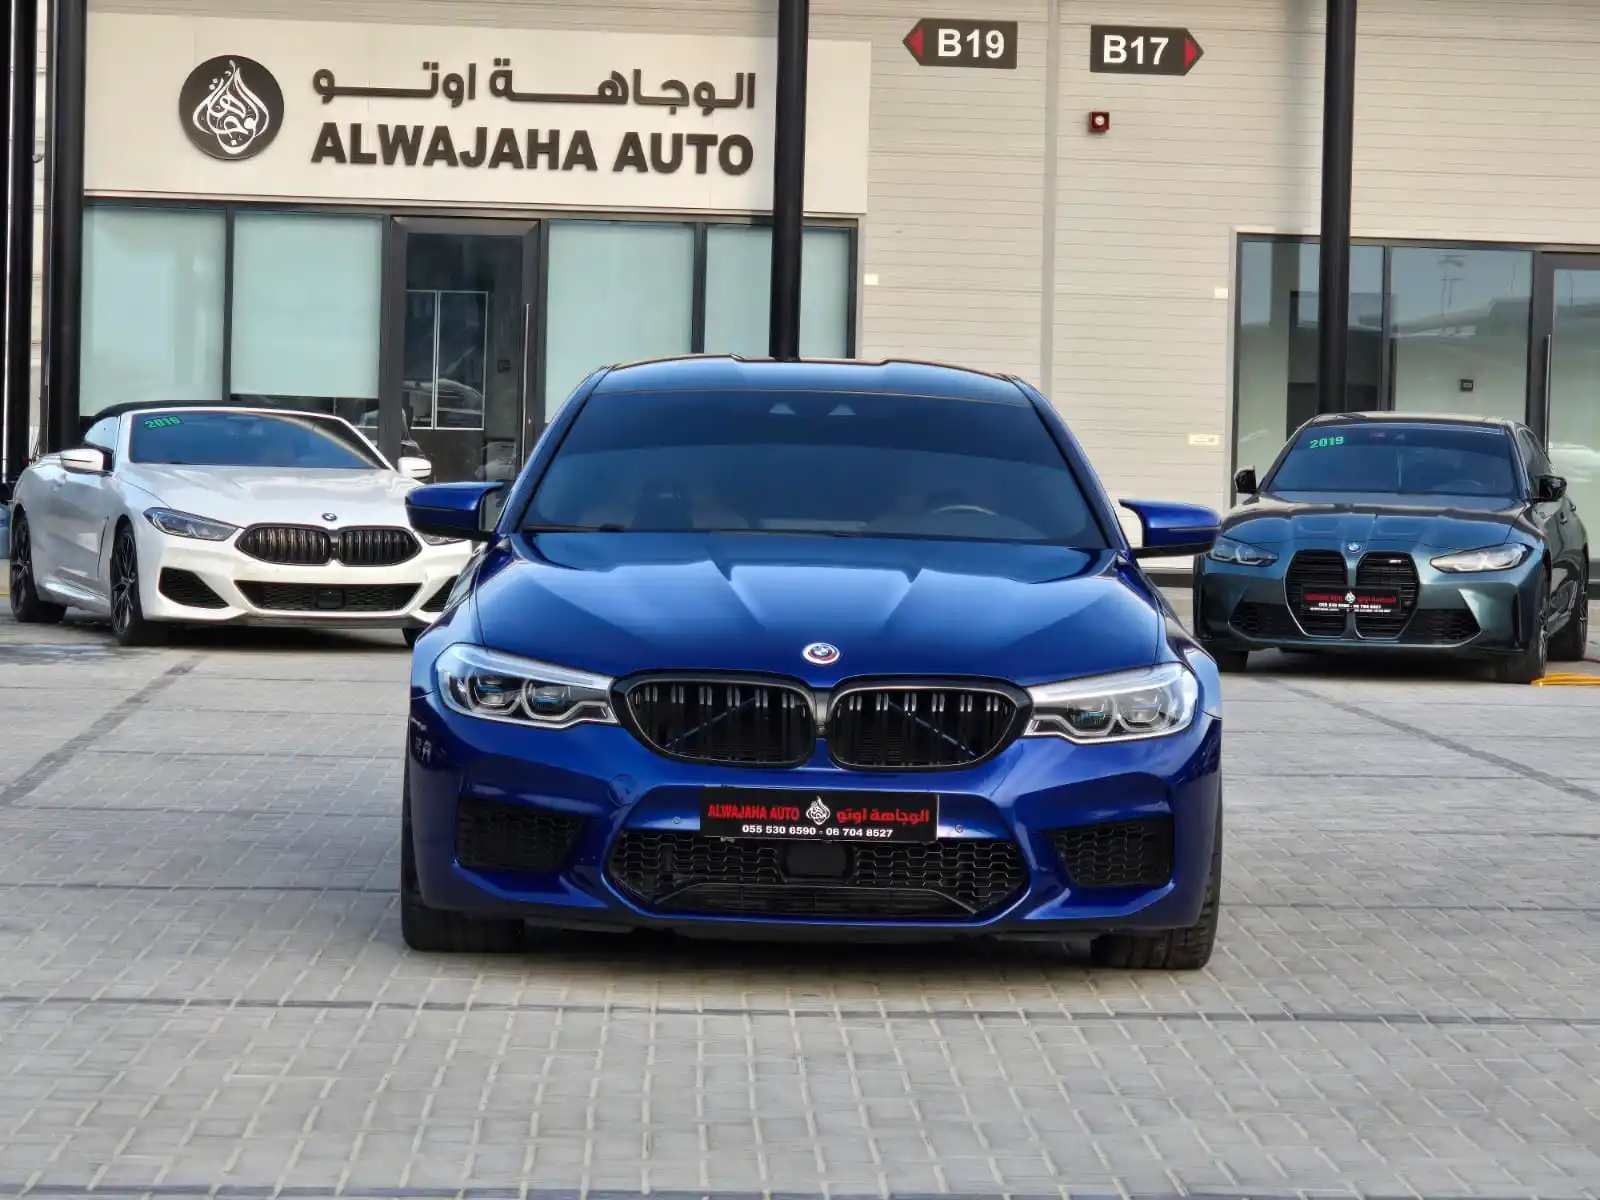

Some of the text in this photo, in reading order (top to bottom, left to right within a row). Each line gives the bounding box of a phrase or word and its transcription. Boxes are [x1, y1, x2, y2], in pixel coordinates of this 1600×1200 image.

[937, 28, 1005, 59] B19
[1103, 34, 1170, 65] B17
[312, 57, 756, 116] الوجاهة اوتو
[310, 121, 754, 176] ALWAJAHA AUTO
[1309, 435, 1345, 449] 2019
[707, 803, 767, 820] ALWAJAHA
[769, 806, 800, 821] AUTO
[742, 824, 763, 834] 055
[765, 825, 787, 835] 530
[788, 826, 817, 837] 6590
[825, 828, 840, 837] 06
[842, 829, 864, 839] 704
[866, 829, 893, 839] 8527
